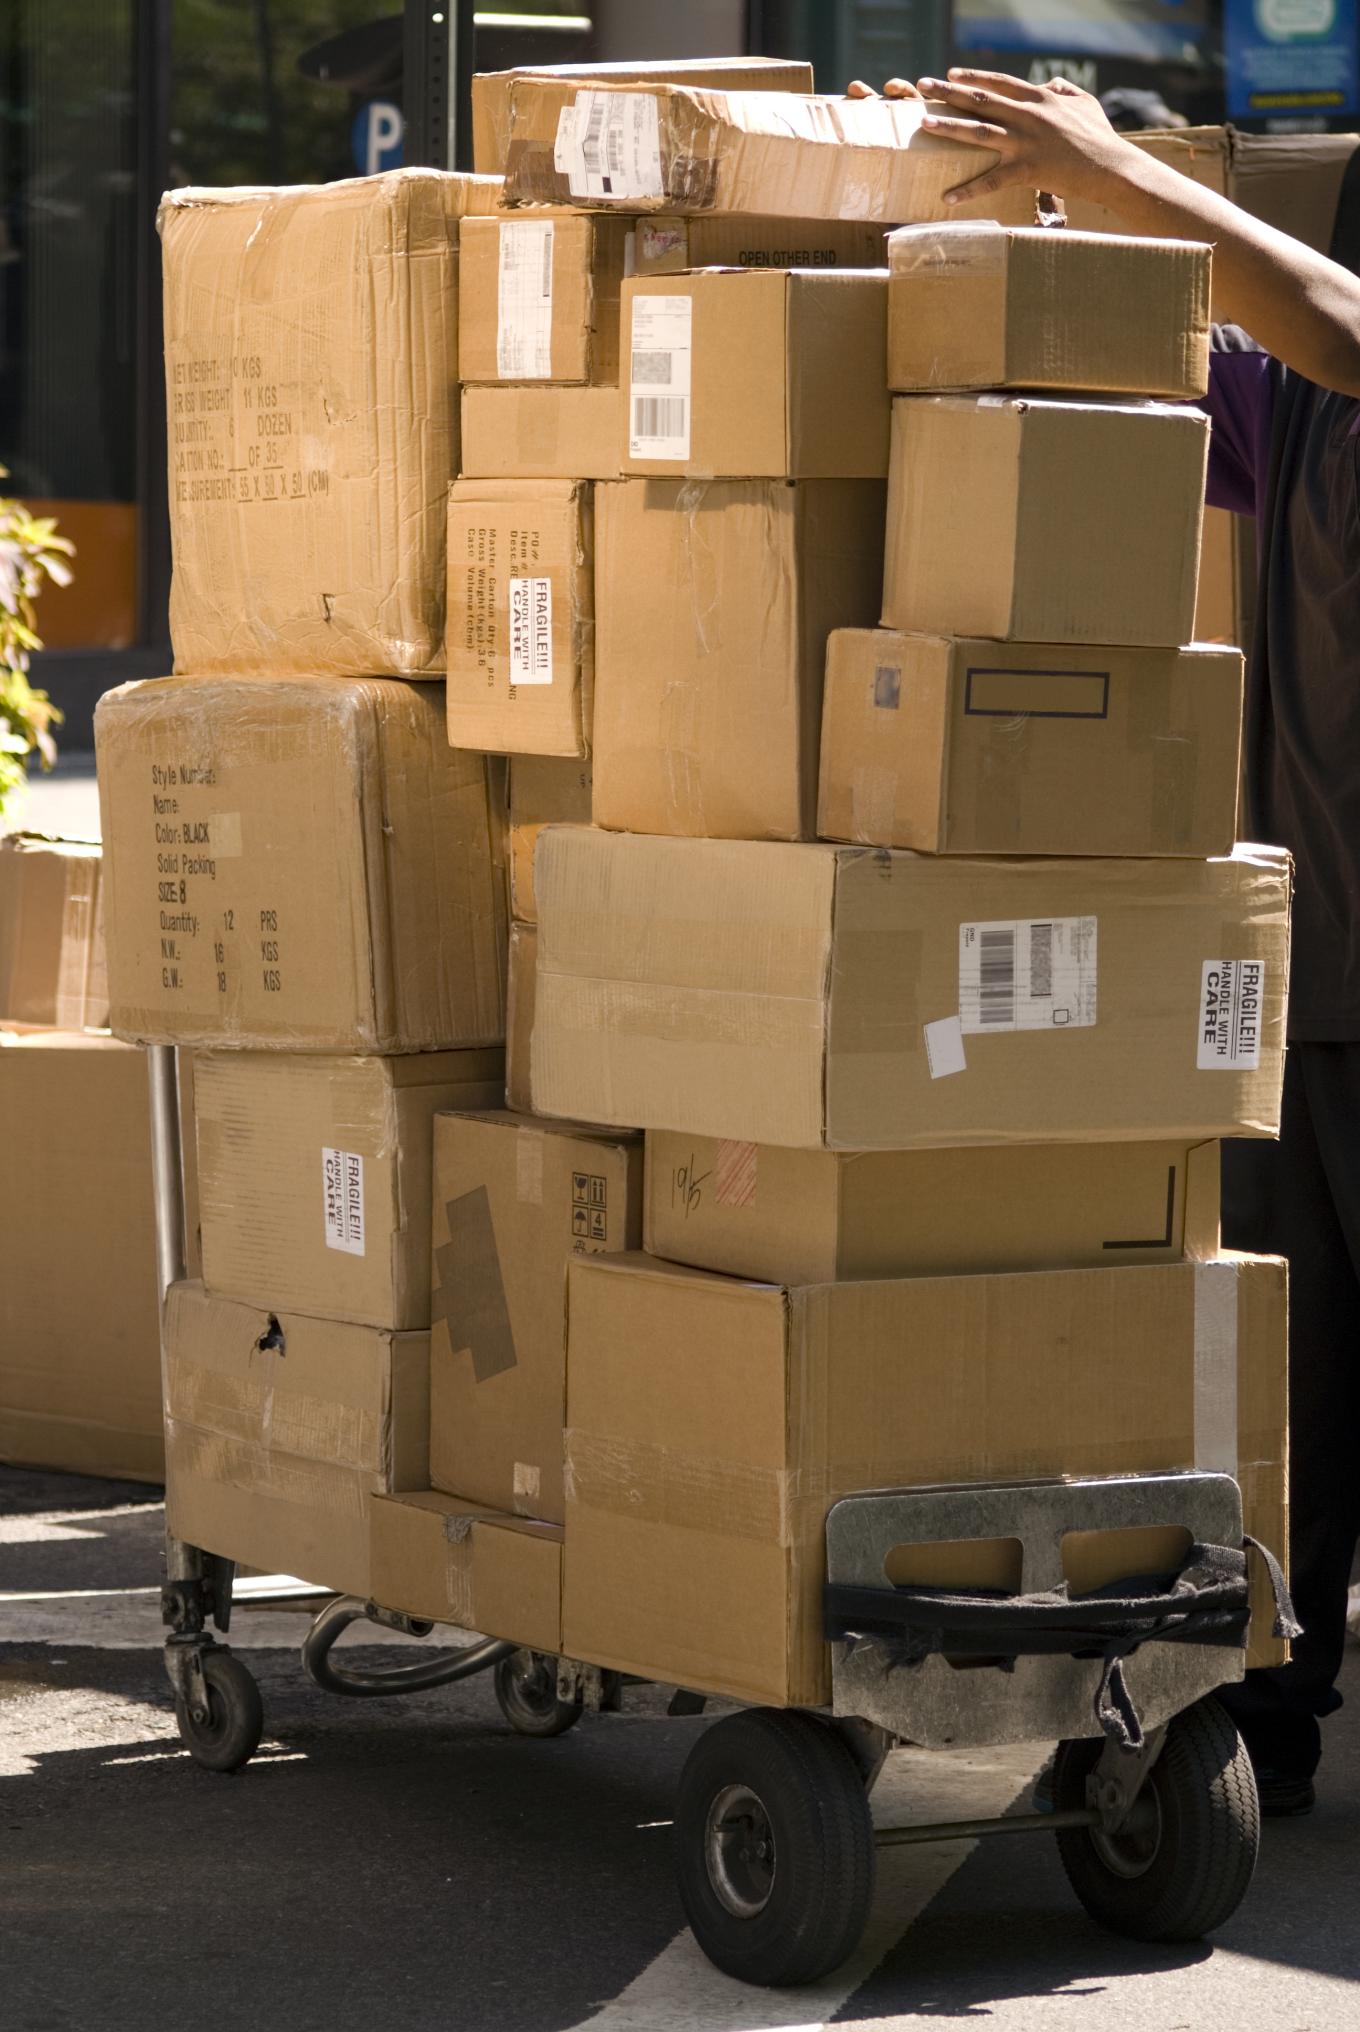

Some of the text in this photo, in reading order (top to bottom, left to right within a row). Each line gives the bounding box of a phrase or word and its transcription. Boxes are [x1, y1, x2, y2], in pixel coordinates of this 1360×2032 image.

[1028, 59, 1098, 94] ATM
[366, 102, 404, 177] P
[739, 249, 837, 266] OPEN OTHER END
[242, 357, 262, 379] KGS
[244, 387, 253, 408] 11
[257, 386, 278, 407] KGS
[257, 413, 293, 437] DOZEN
[249, 446, 261, 467] OF
[254, 475, 261, 497] X
[281, 473, 288, 495] X
[292, 471, 303, 494] 50
[467, 528, 475, 557] Case
[489, 528, 497, 569] Master
[488, 577, 497, 618] Carton
[536, 582, 549, 668] FRAGILE!!!
[487, 667, 495, 687] pcs
[152, 765, 177, 791] Style
[153, 794, 179, 814] Name:
[156, 822, 210, 844] Color: BLACK
[157, 853, 216, 880] Solid Packing
[180, 880, 186, 904] 8
[160, 909, 278, 937] Quantity: 12 PRS
[214, 942, 224, 963] 16
[261, 941, 279, 962] KGS
[217, 971, 226, 992] 18
[263, 970, 281, 992] KGS
[1204, 971, 1219, 1044] CARE
[1216, 961, 1232, 1055] HANDLE WITH
[1239, 964, 1260, 1053] FRAGILE!!!
[326, 1159, 336, 1225] CARE
[334, 1150, 344, 1237] HANDLE WITH
[348, 1156, 361, 1240] FRAGILE!!!
